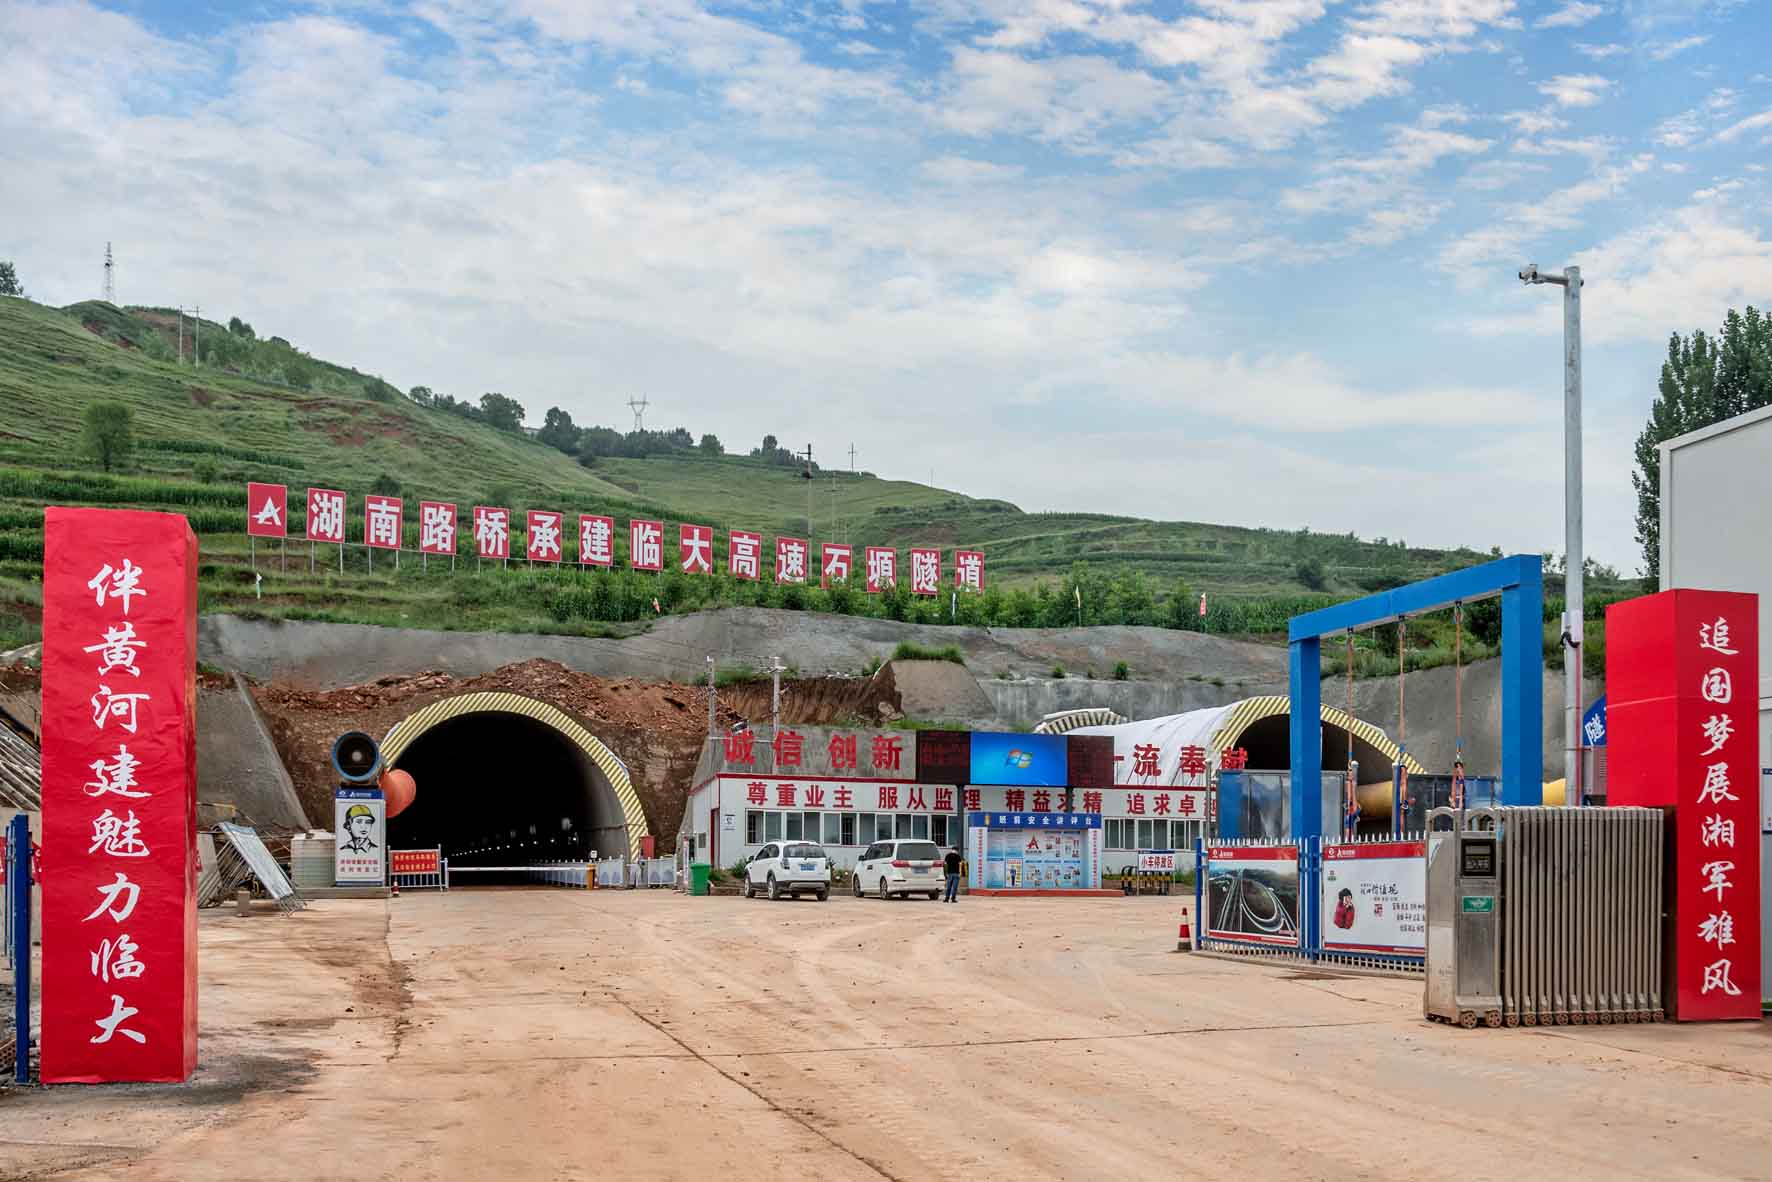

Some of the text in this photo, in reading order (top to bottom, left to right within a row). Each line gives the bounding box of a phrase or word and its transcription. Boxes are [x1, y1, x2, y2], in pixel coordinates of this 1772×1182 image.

[1585, 707, 1607, 747] 隧
[723, 729, 904, 770] 诚信创新
[82, 558, 153, 1044] 伴黄河建魅力临大
[747, 781, 854, 809] 尊重业主
[878, 786, 981, 811] 服从监理
[1006, 788, 1103, 814] 精益求精
[1697, 617, 1742, 996] 追国梦展湘军雄风
